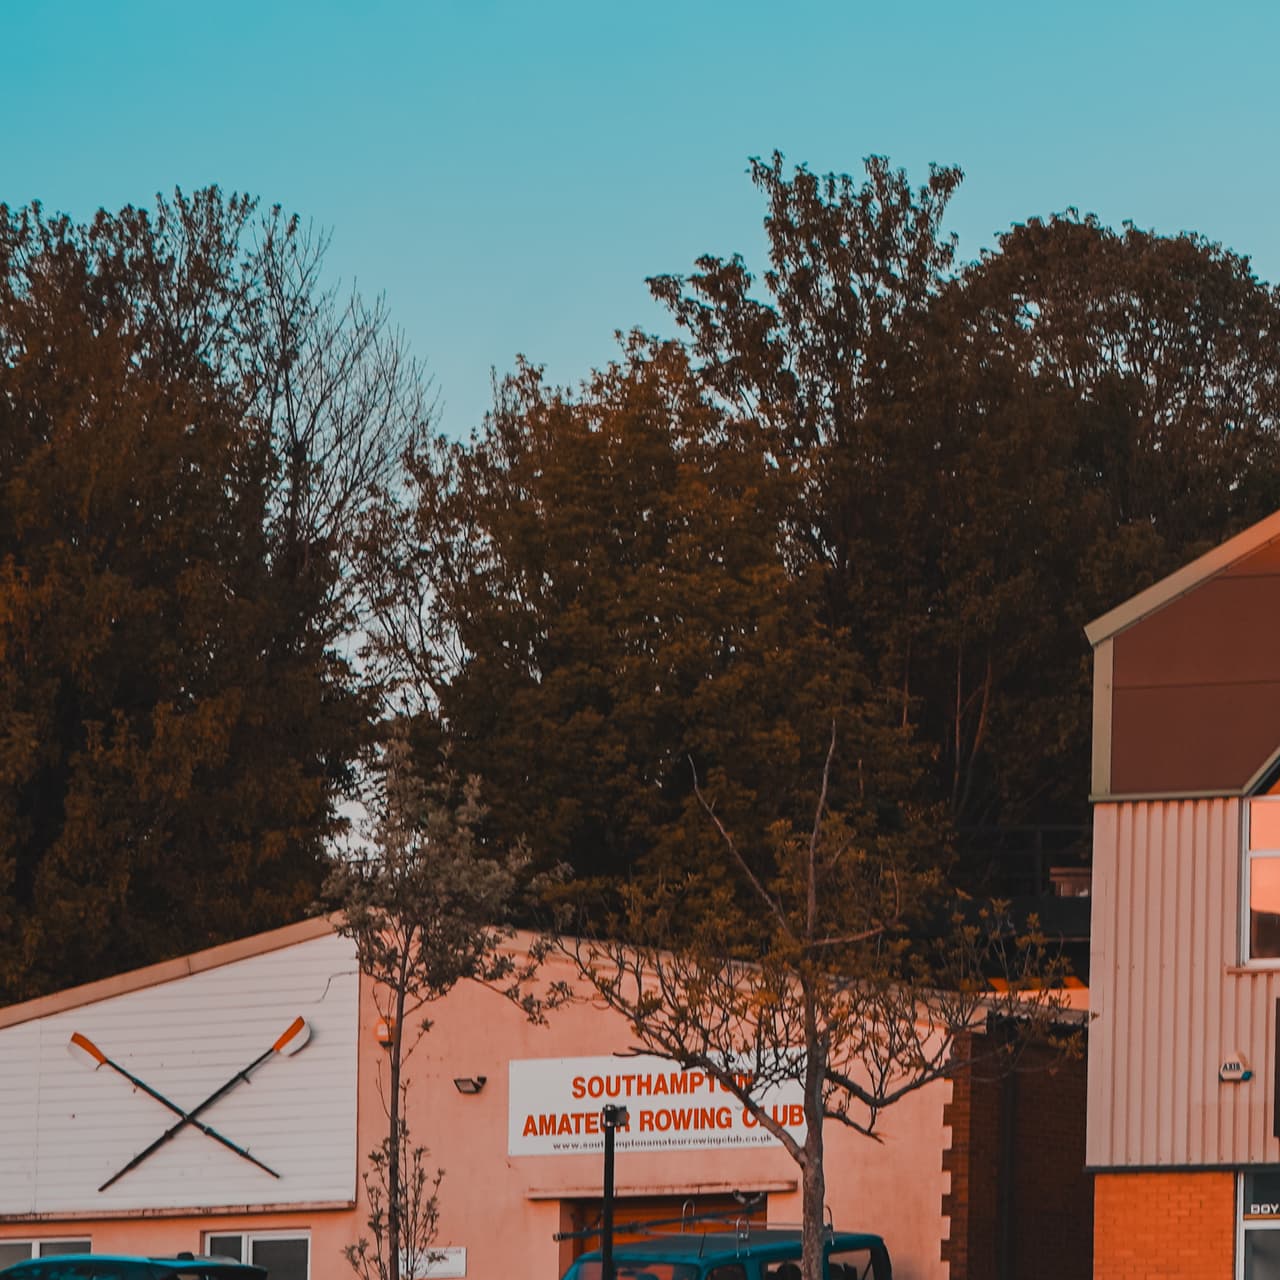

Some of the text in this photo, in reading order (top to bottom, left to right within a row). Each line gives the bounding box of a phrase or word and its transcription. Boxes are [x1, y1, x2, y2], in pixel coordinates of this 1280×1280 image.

[522, 1104, 805, 1136] AMATE ROWING CUB
[552, 1134, 773, 1150] www.soutmptonamateurrowingclub.co.uk
